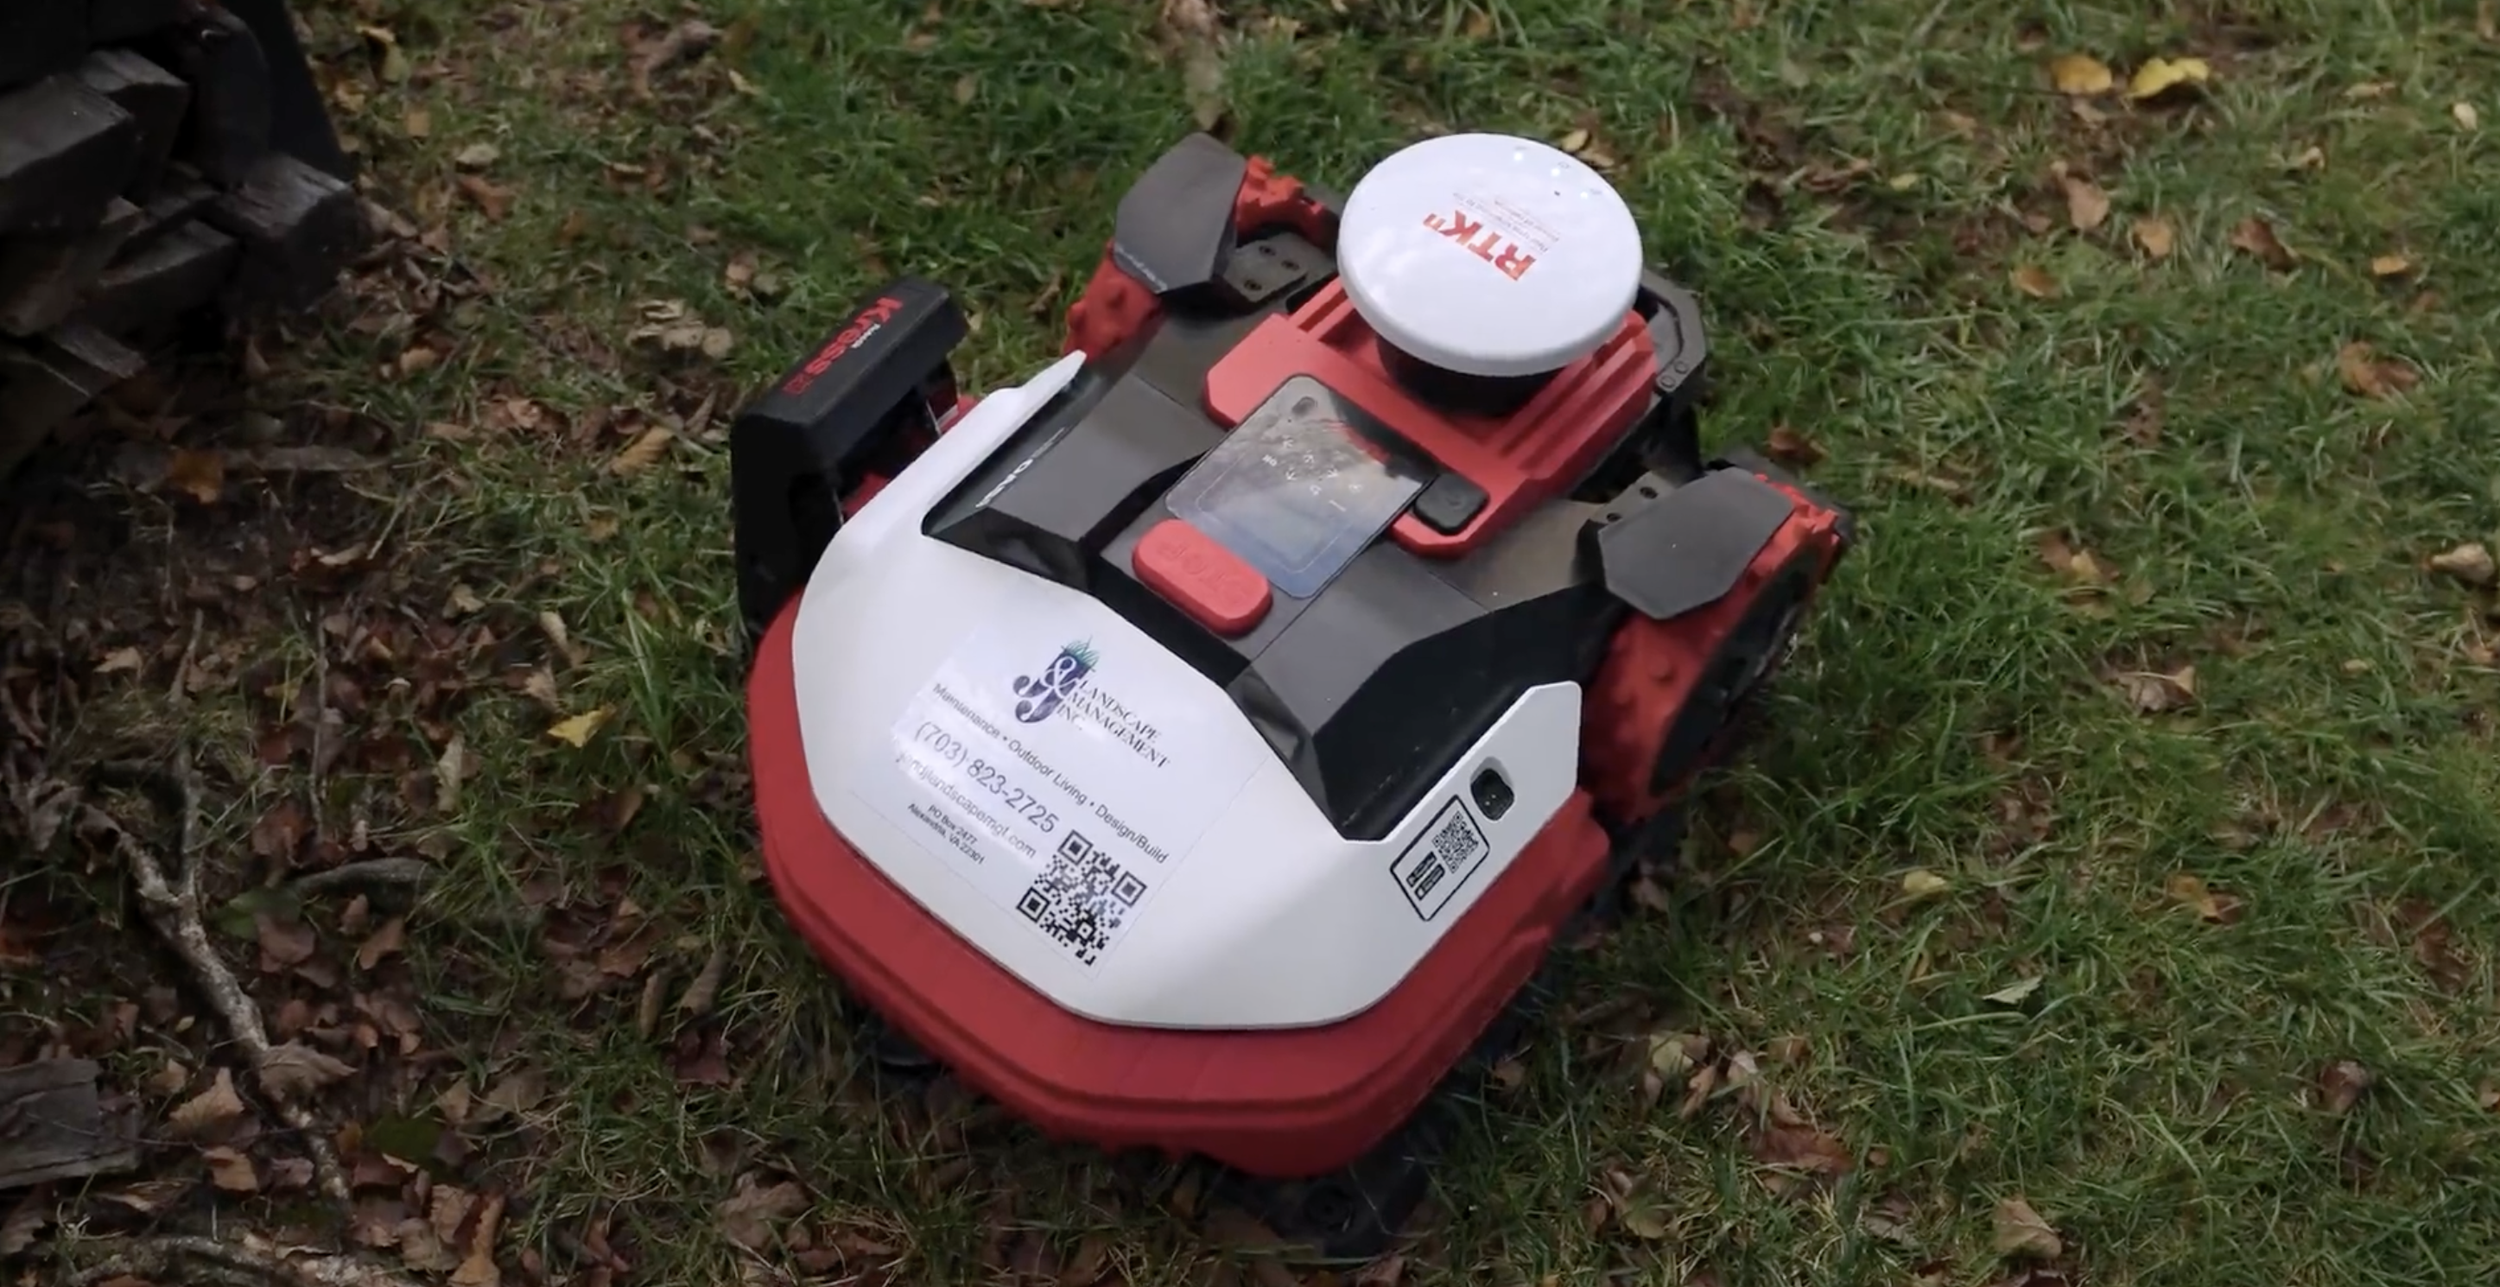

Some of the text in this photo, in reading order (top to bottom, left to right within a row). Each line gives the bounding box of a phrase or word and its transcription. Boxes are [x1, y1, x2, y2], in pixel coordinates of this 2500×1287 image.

[802, 295, 905, 376] Kress
[1055, 703, 1083, 731] INC.
[1066, 692, 1172, 769] MANAGEMENT
[1077, 679, 1163, 742] LANDSCAPE
[915, 720, 1060, 835] (703) 823-2725
[932, 682, 1170, 865] Maintenance Outdoor Living Design/Build
[927, 803, 979, 846] PO Box 2477
[948, 833, 962, 849] VA
[957, 840, 986, 865] 22301
